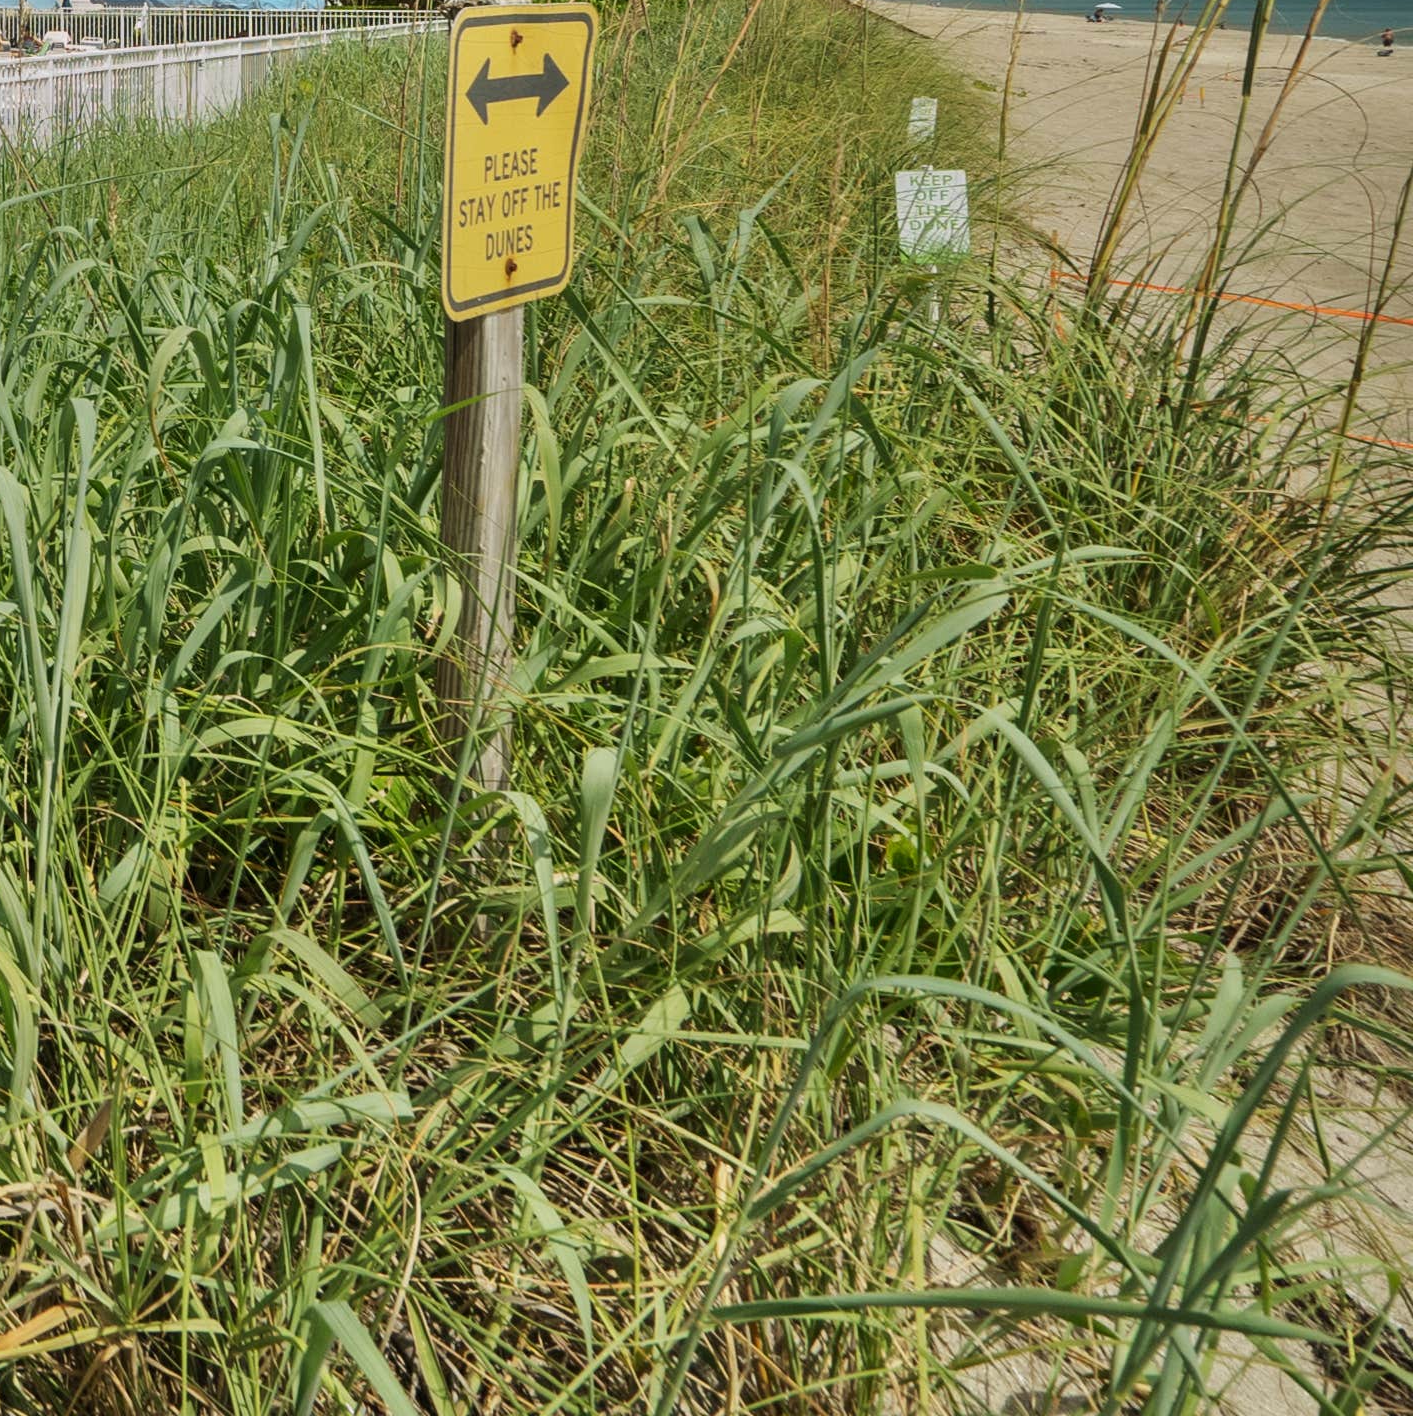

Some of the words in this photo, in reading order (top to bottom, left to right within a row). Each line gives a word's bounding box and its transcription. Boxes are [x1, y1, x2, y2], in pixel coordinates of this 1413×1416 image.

[484, 148, 538, 183] PLEASE
[909, 175, 953, 186] KEEP
[459, 193, 496, 228] STAY
[502, 187, 529, 218] OFF
[534, 181, 561, 211] THE
[916, 190, 949, 201] OFF
[916, 205, 950, 216] THE
[486, 224, 533, 261] DUNES
